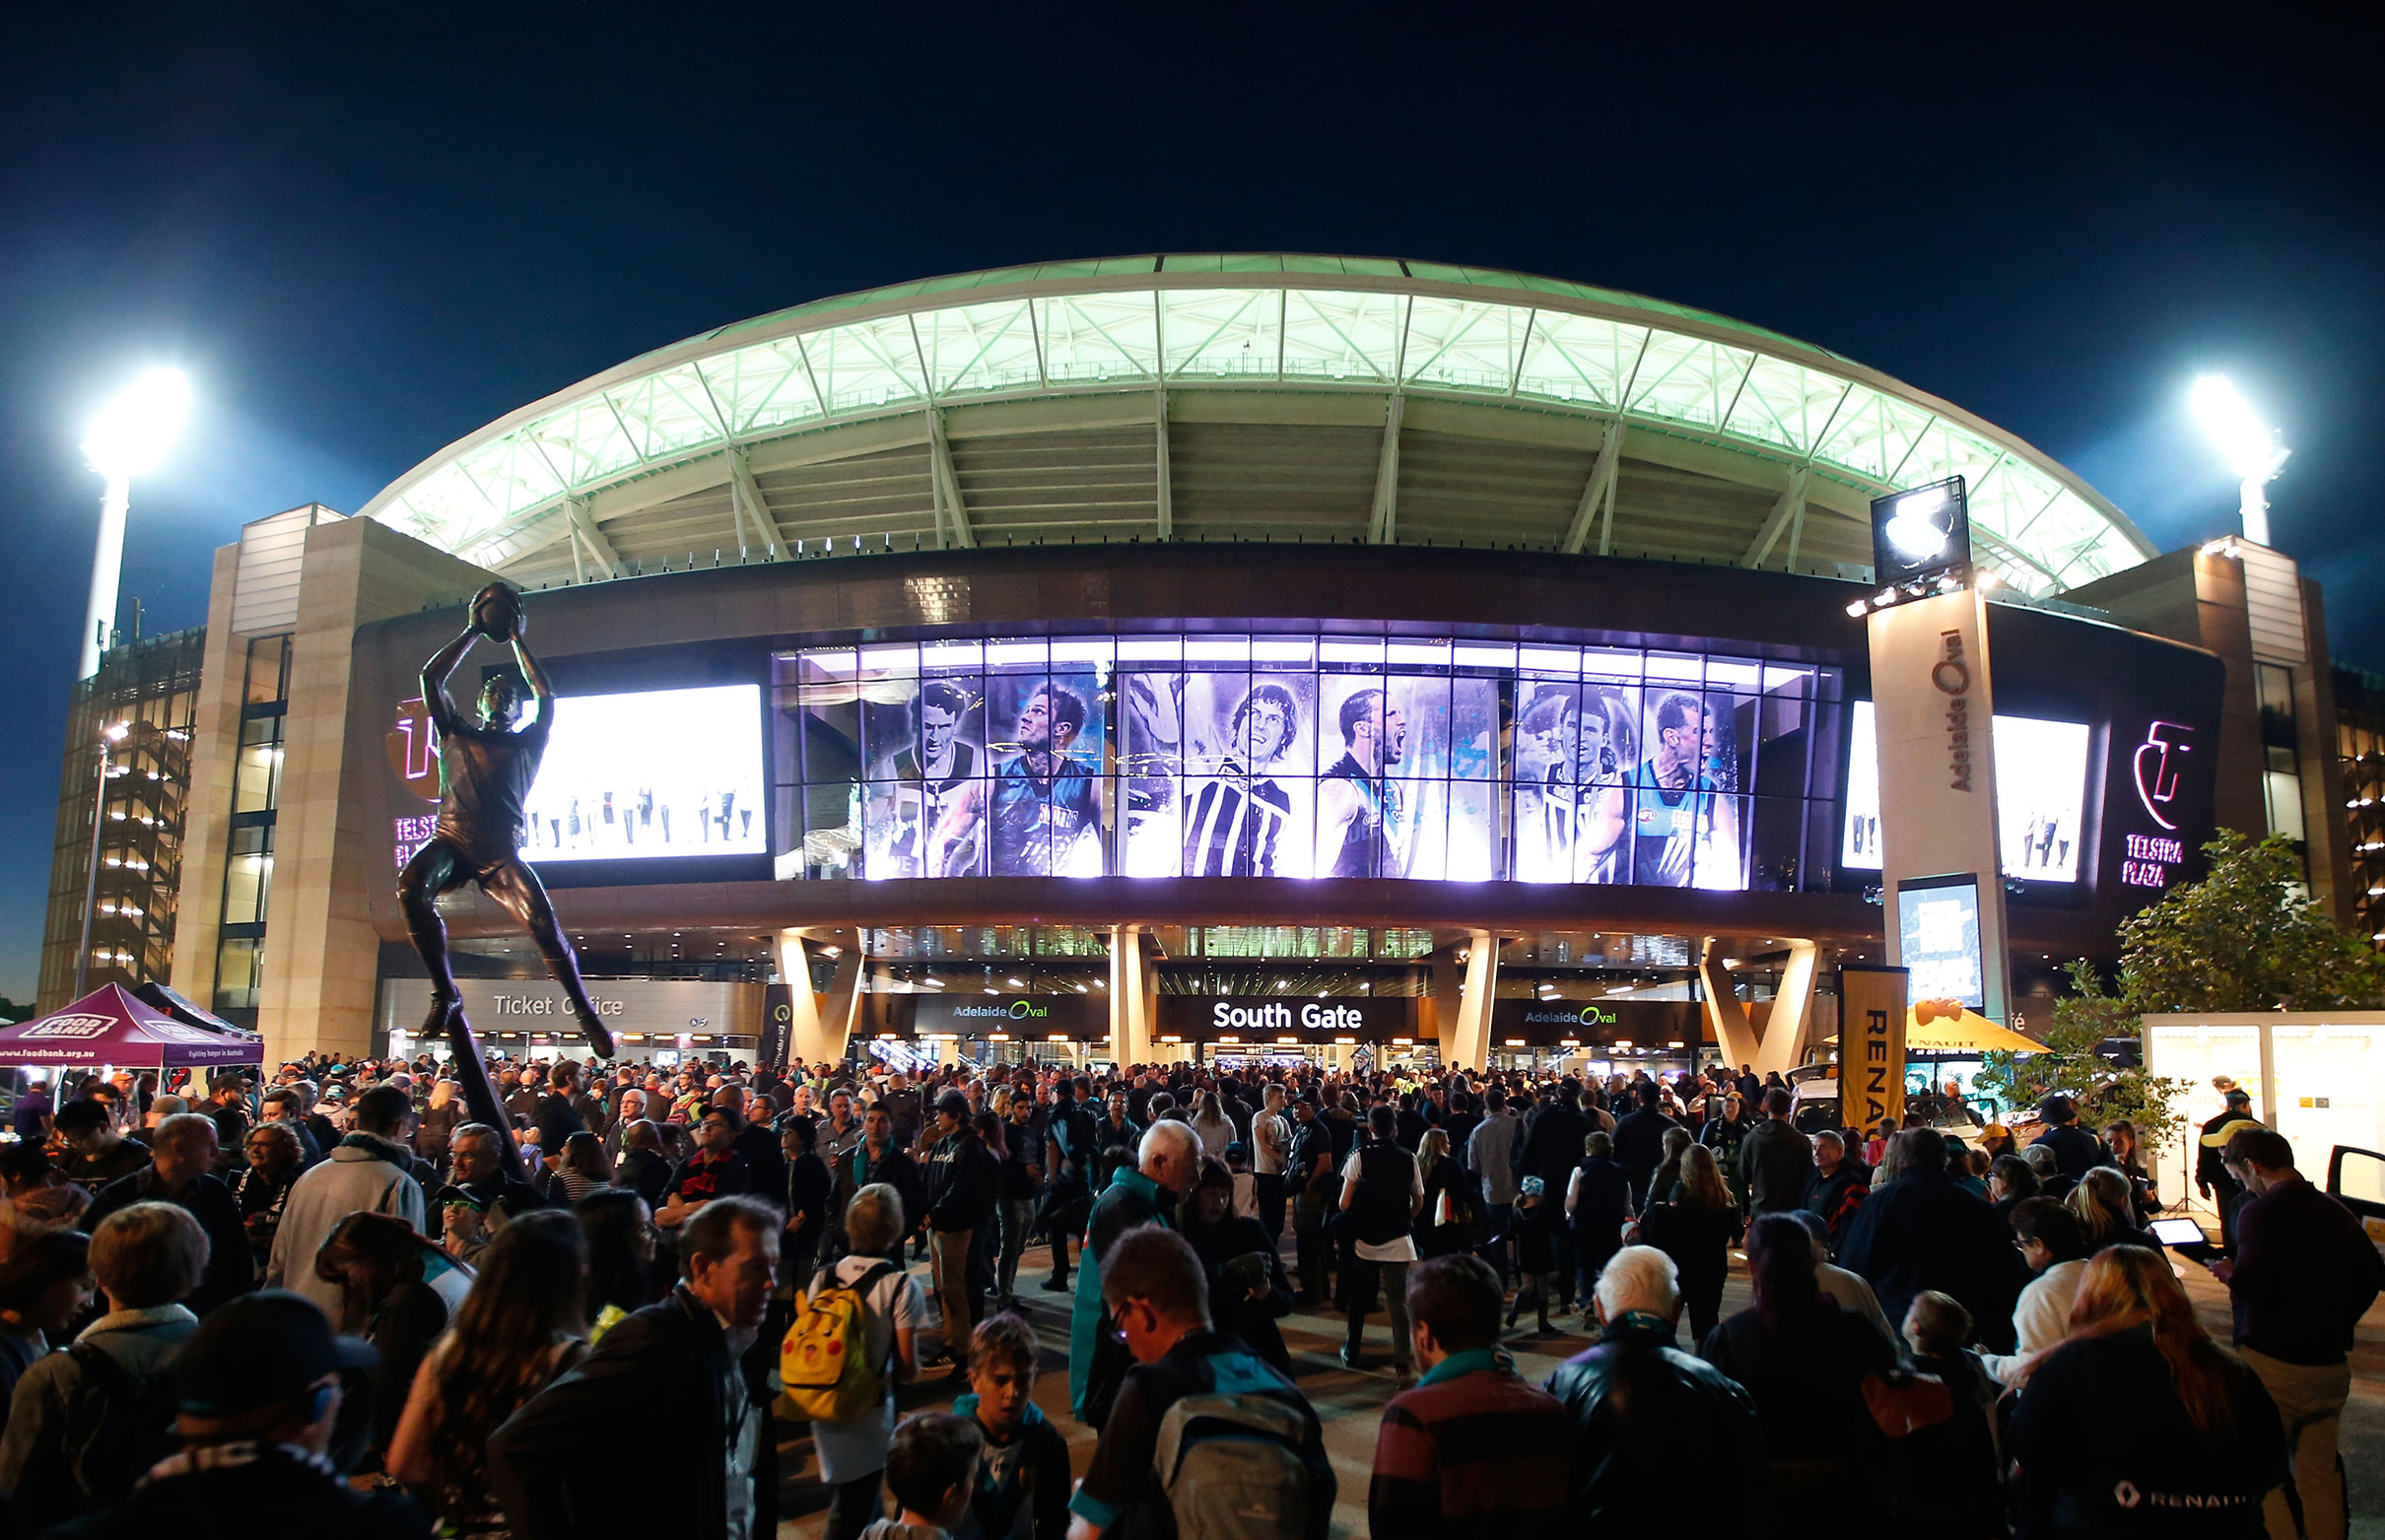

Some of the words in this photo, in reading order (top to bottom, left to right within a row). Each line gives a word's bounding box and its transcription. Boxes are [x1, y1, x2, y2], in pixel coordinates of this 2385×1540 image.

[1932, 629, 1969, 696] Oval
[1945, 699, 1970, 792] Adelaide
[394, 815, 439, 840] TELST
[2127, 835, 2183, 863] TELSTRA
[2122, 861, 2164, 887] PLAZA
[494, 995, 552, 1015] Ticket
[561, 995, 624, 1016] Oice
[953, 1006, 1007, 1017] Adelaide
[1008, 1000, 1048, 1020] Oval
[1213, 1002, 1292, 1028] South
[1301, 1003, 1363, 1029] Gate
[1525, 1012, 1578, 1023] Adelaide
[1580, 1006, 1616, 1026] Oval
[34, 1026, 95, 1035] BANK
[45, 1018, 102, 1028] FOOD
[0, 1049, 95, 1058] www.foodbank.org.au
